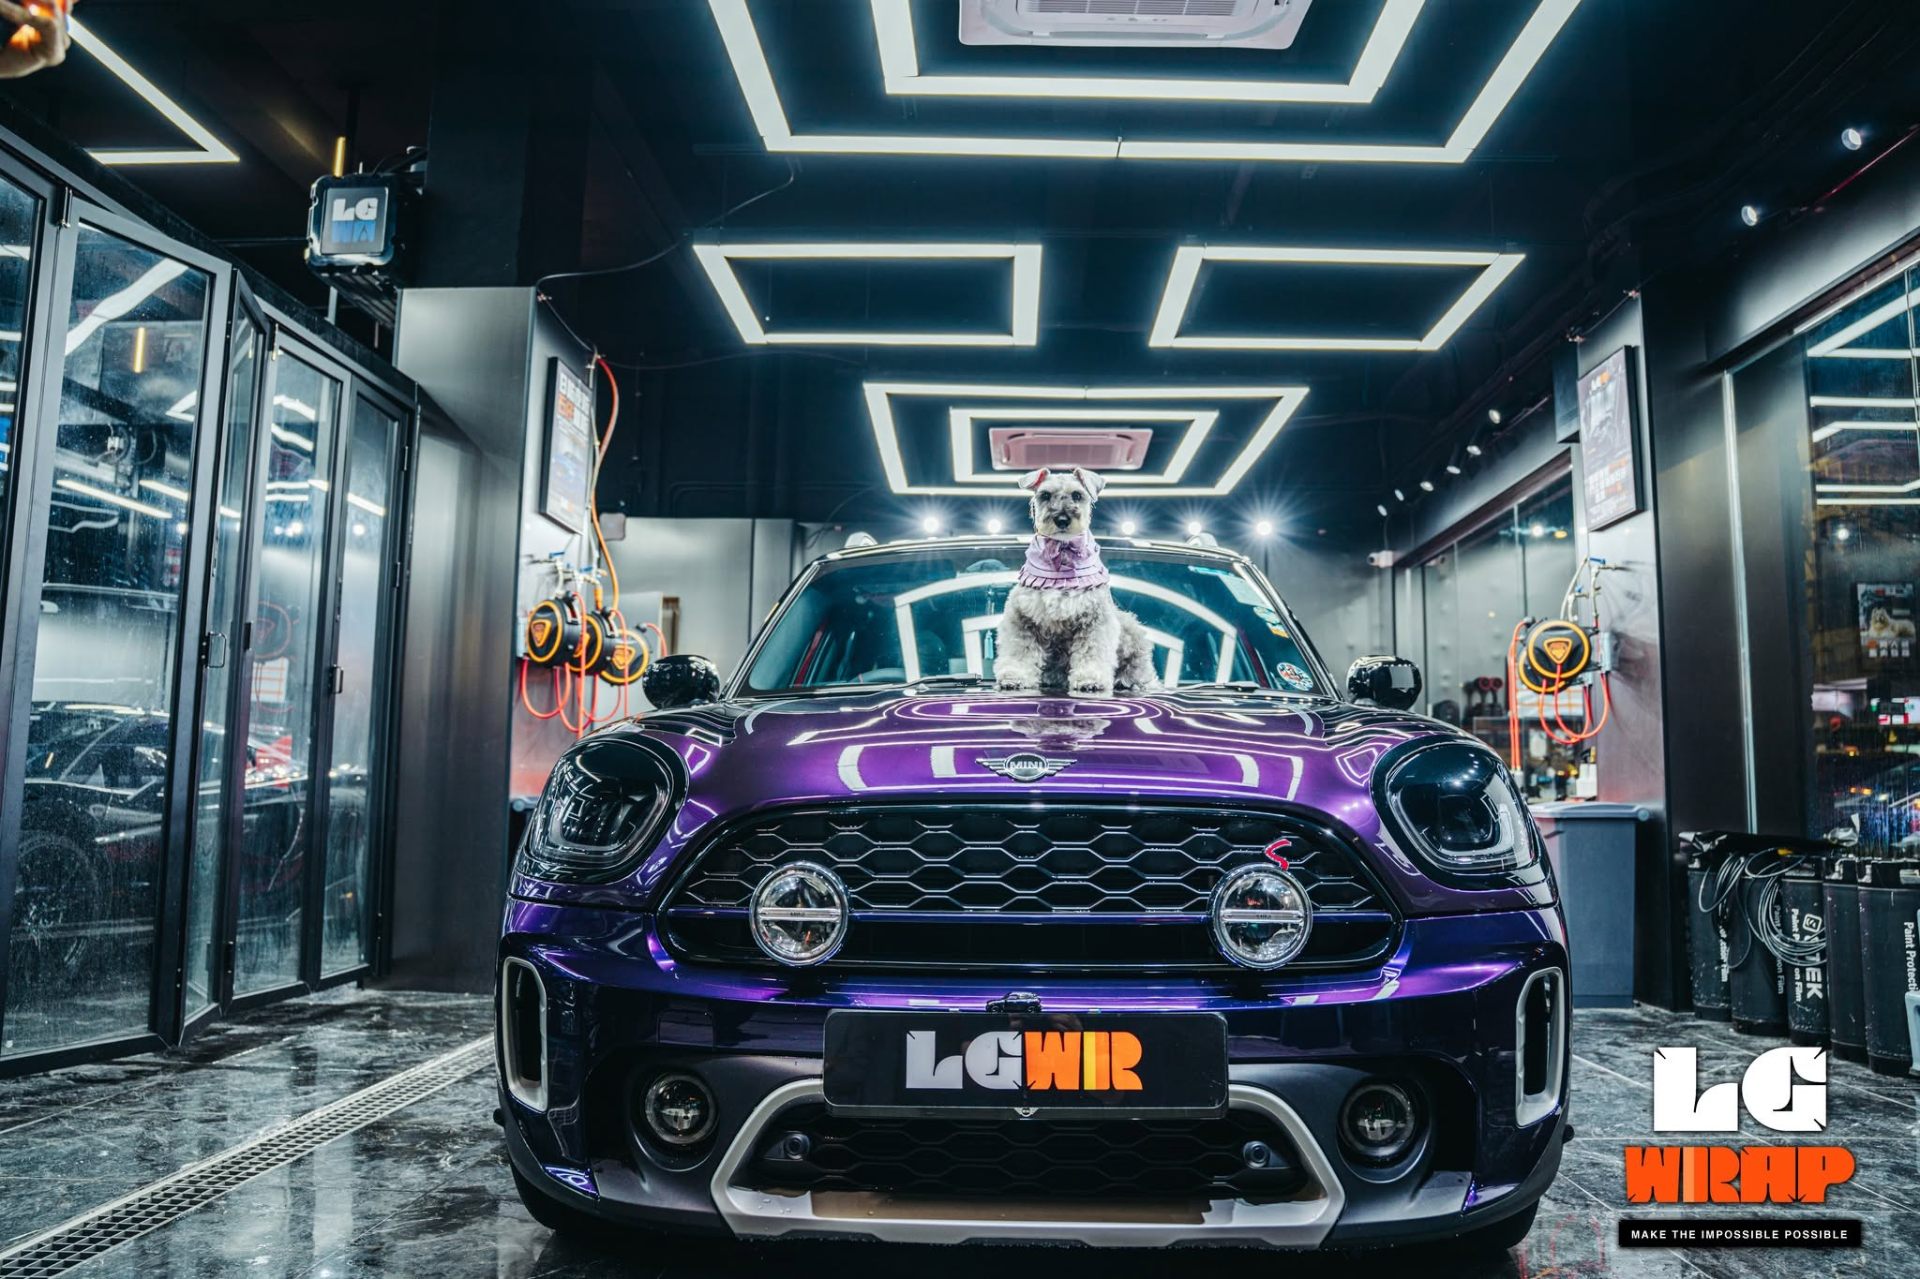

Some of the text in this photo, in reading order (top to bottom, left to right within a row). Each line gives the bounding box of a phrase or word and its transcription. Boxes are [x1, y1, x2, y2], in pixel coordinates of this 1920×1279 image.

[332, 198, 378, 221] LG
[1010, 760, 1043, 770] MINI
[1903, 922, 1919, 992] Paint Protecti
